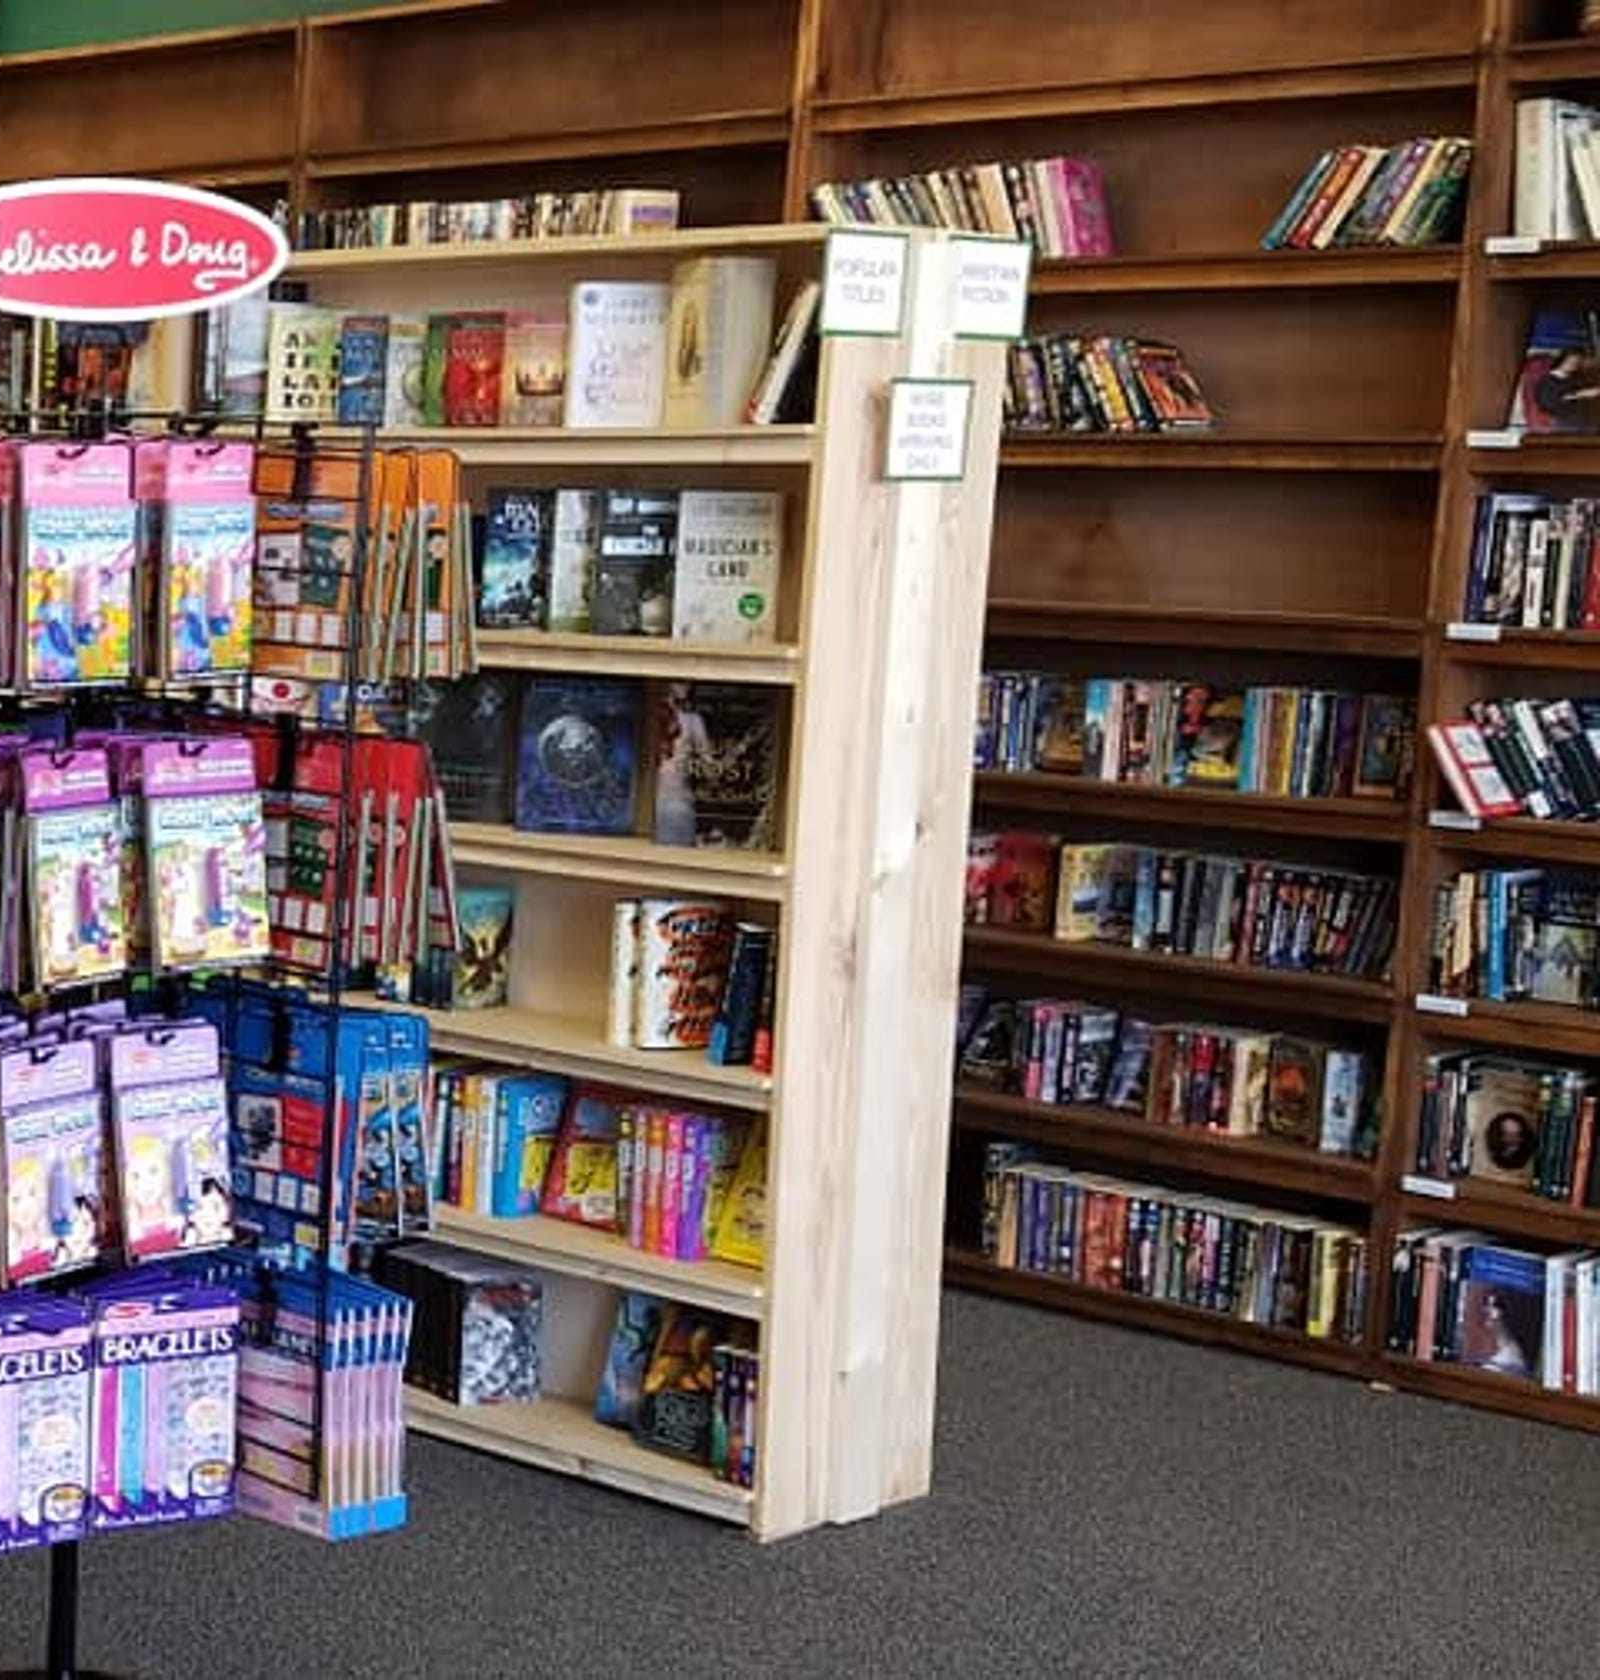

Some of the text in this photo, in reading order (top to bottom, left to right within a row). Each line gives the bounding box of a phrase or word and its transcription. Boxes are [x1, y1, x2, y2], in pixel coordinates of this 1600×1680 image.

[160, 221, 250, 290] Doug
[833, 259, 898, 278] POPULAR
[841, 284, 886, 303] TITLES
[103, 1328, 234, 1363] BRACELETS
